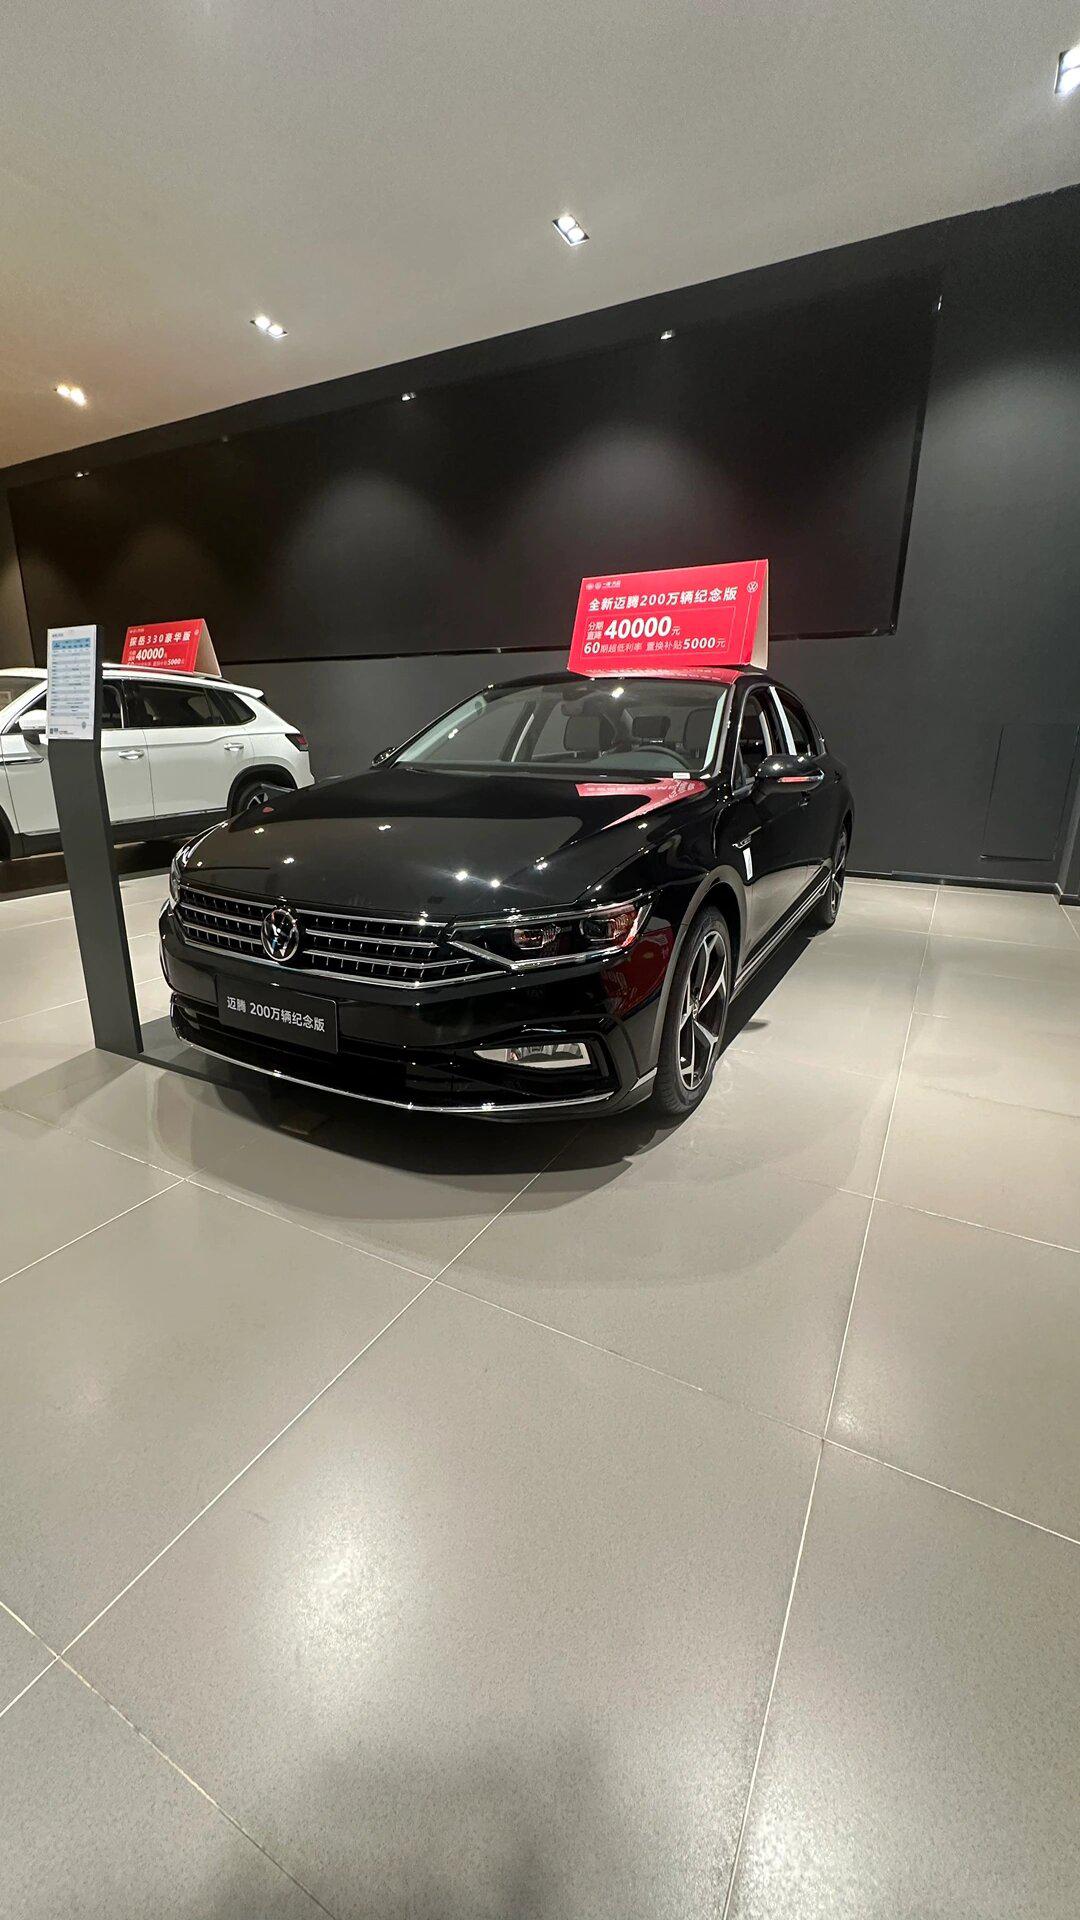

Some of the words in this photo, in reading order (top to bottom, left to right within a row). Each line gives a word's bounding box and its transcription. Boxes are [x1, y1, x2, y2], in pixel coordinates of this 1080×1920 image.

[588, 586, 738, 612] 全新迈腾200万辆纪念版
[604, 616, 681, 640] 40000元
[226, 996, 247, 1013] 迈腾
[249, 1002, 326, 1032] 200万辆纪念版
